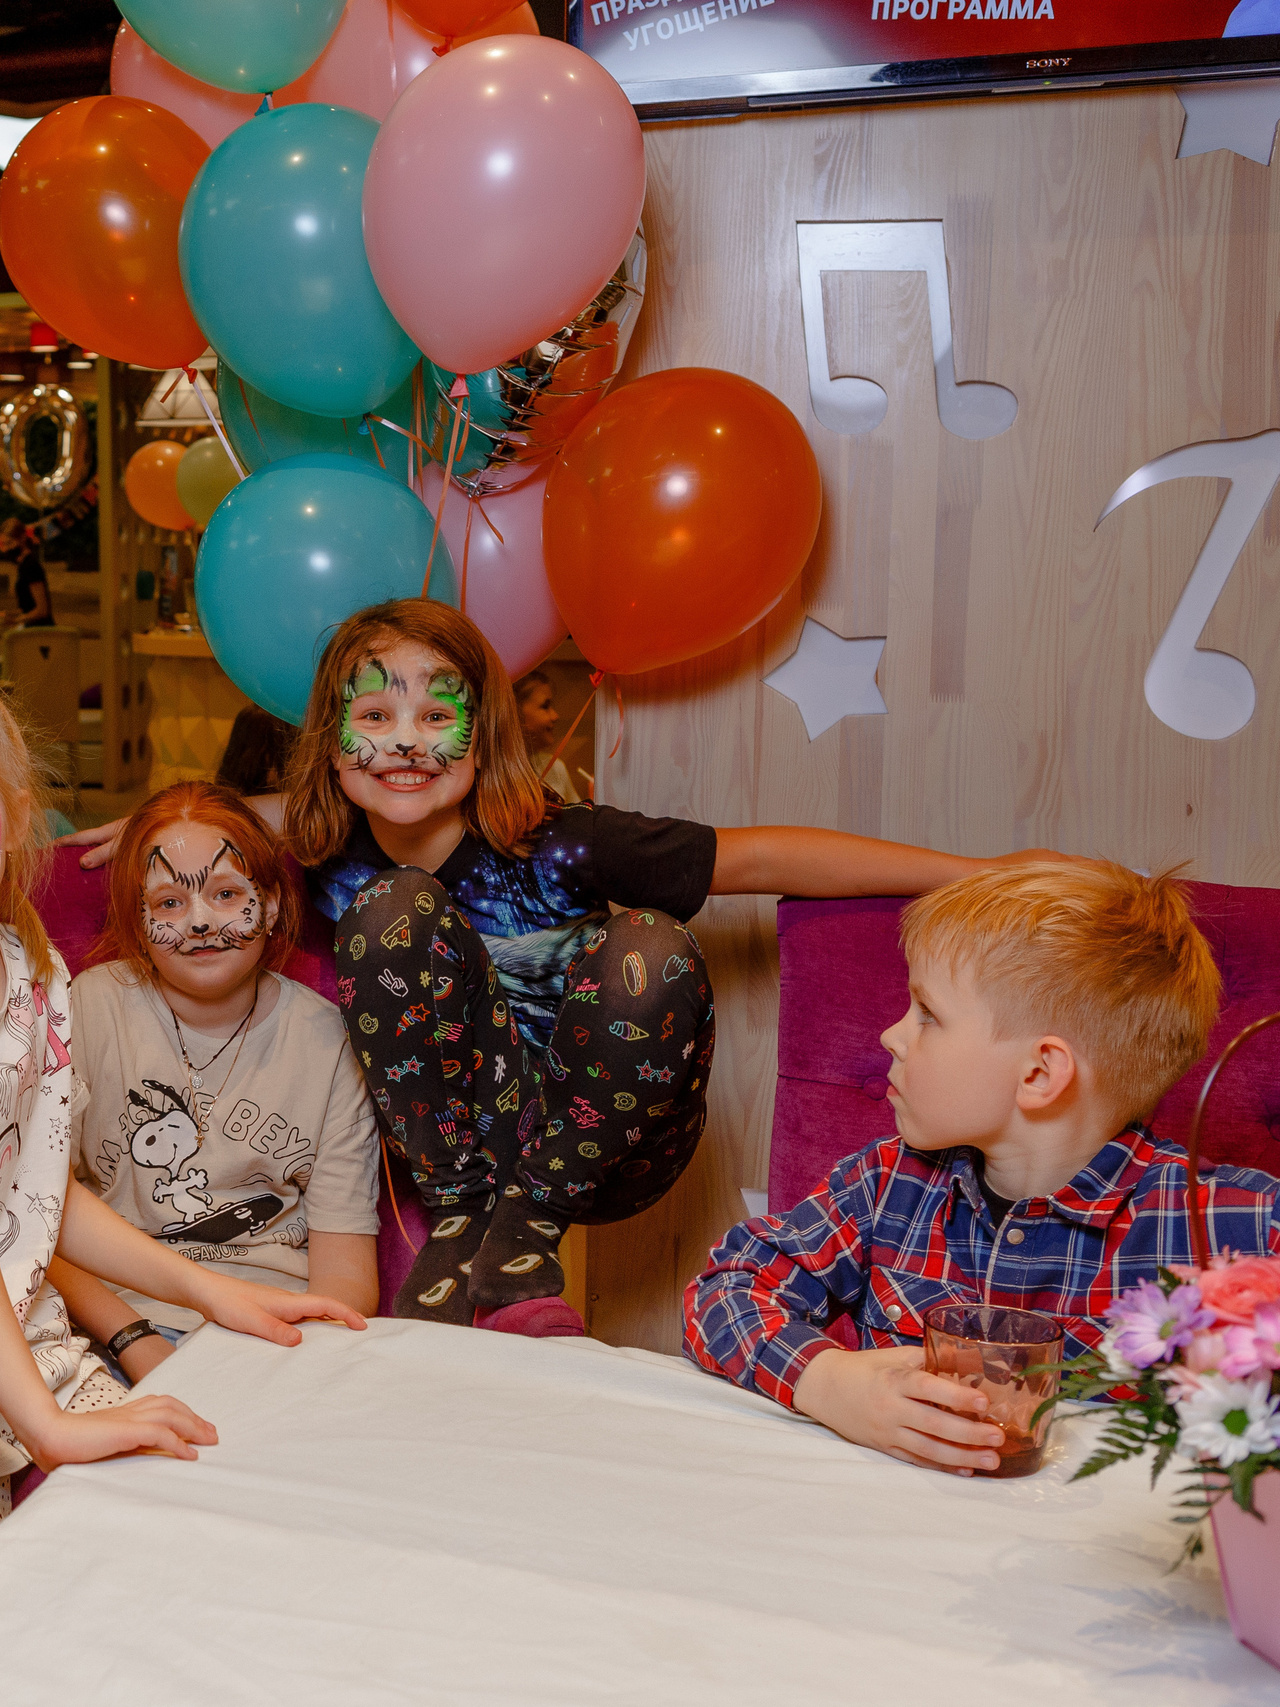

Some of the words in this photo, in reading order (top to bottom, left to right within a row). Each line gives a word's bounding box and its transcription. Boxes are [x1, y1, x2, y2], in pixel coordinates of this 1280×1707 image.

[590, 0, 671, 26] ПРА
[871, 0, 1055, 20] ПРОГРАММА
[1026, 57, 1073, 69] SONY
[445, 1023, 464, 1042] FUN
